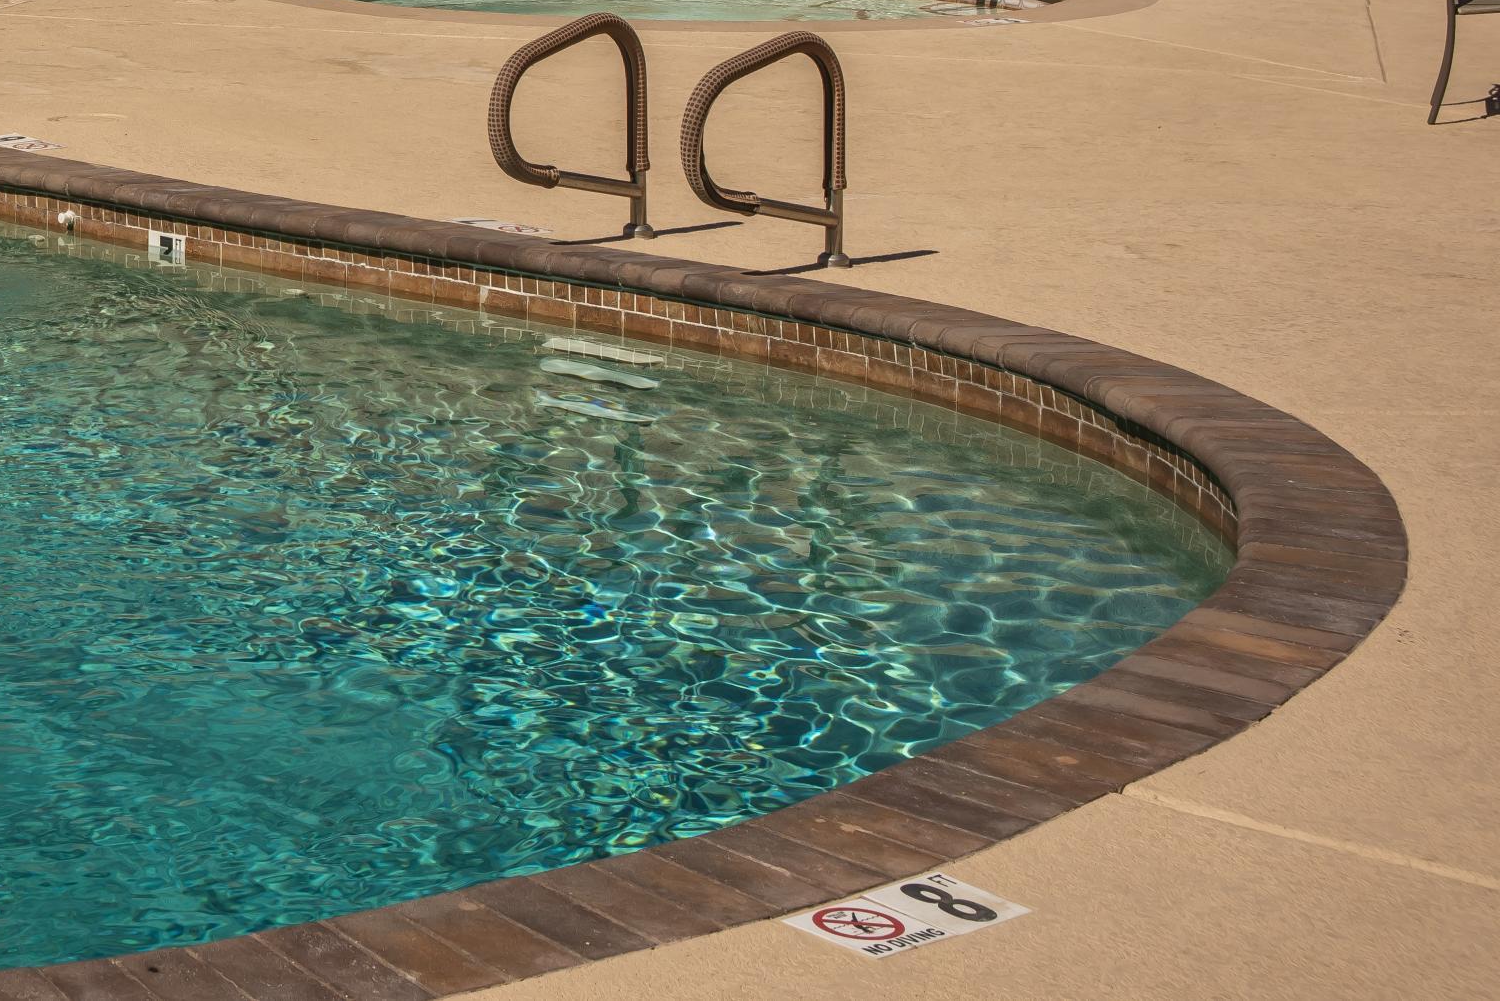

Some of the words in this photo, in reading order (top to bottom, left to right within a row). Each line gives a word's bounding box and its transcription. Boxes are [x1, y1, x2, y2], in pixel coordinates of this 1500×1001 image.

[927, 874, 958, 888] FT
[900, 883, 998, 922] 8
[862, 944, 893, 956] NO
[892, 928, 946, 950] DIVING
